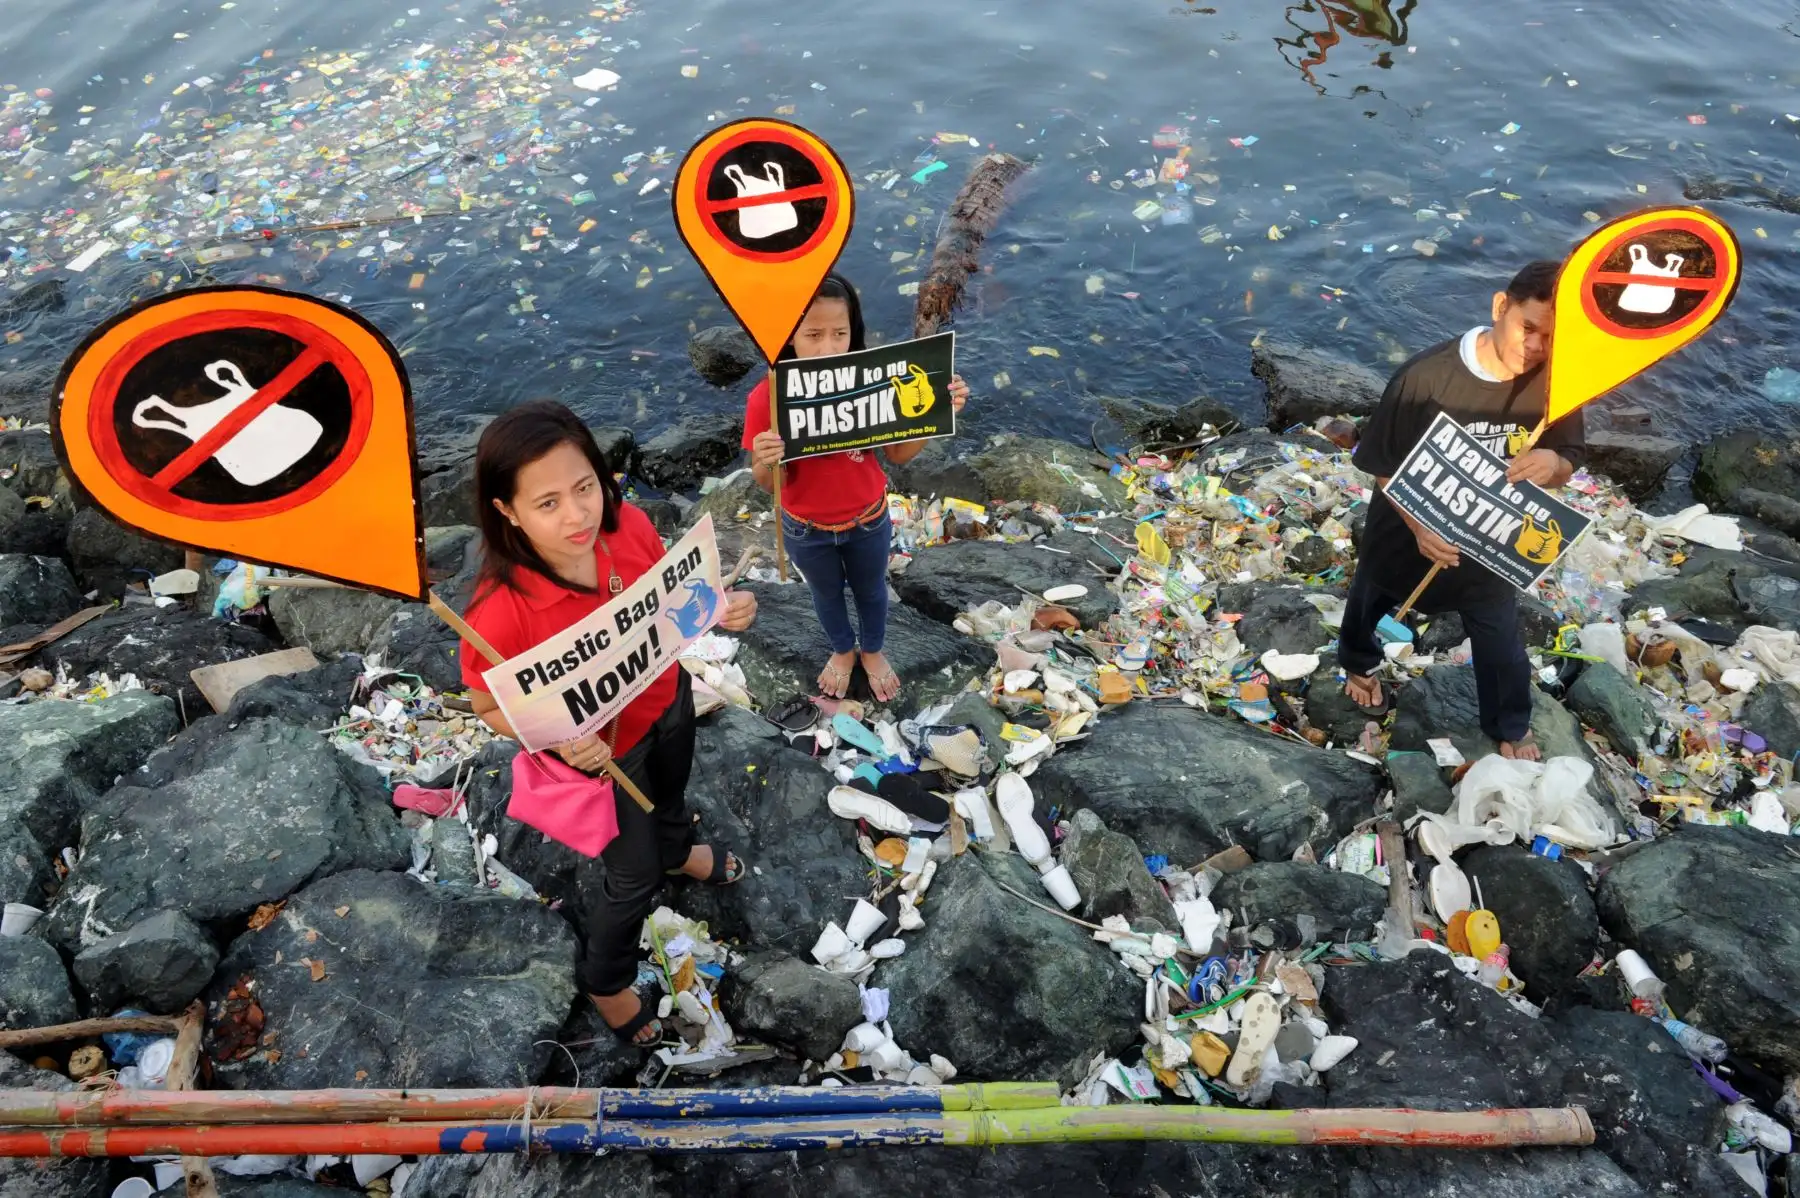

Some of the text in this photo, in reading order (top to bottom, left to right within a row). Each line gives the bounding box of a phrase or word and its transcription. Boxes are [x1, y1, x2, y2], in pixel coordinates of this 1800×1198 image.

[786, 360, 907, 399] Ayaw ko ng
[788, 387, 897, 440] PLASTIK
[828, 437, 871, 449] International
[871, 433, 894, 443] Plastic
[924, 425, 937, 434] Day
[1489, 424, 1502, 434] ko
[1503, 423, 1517, 432] ng
[1407, 450, 1524, 546] PLASTIK
[1431, 423, 1504, 488] Ayaw
[1499, 484, 1525, 505] ko
[1524, 500, 1552, 523] ng
[1398, 477, 1425, 503] Prevent
[1422, 500, 1447, 523] Plastic
[1484, 544, 1497, 554] Go
[1510, 574, 1525, 586] Day
[514, 546, 702, 695] Plastic Bag Ban
[561, 624, 662, 727] Now!
